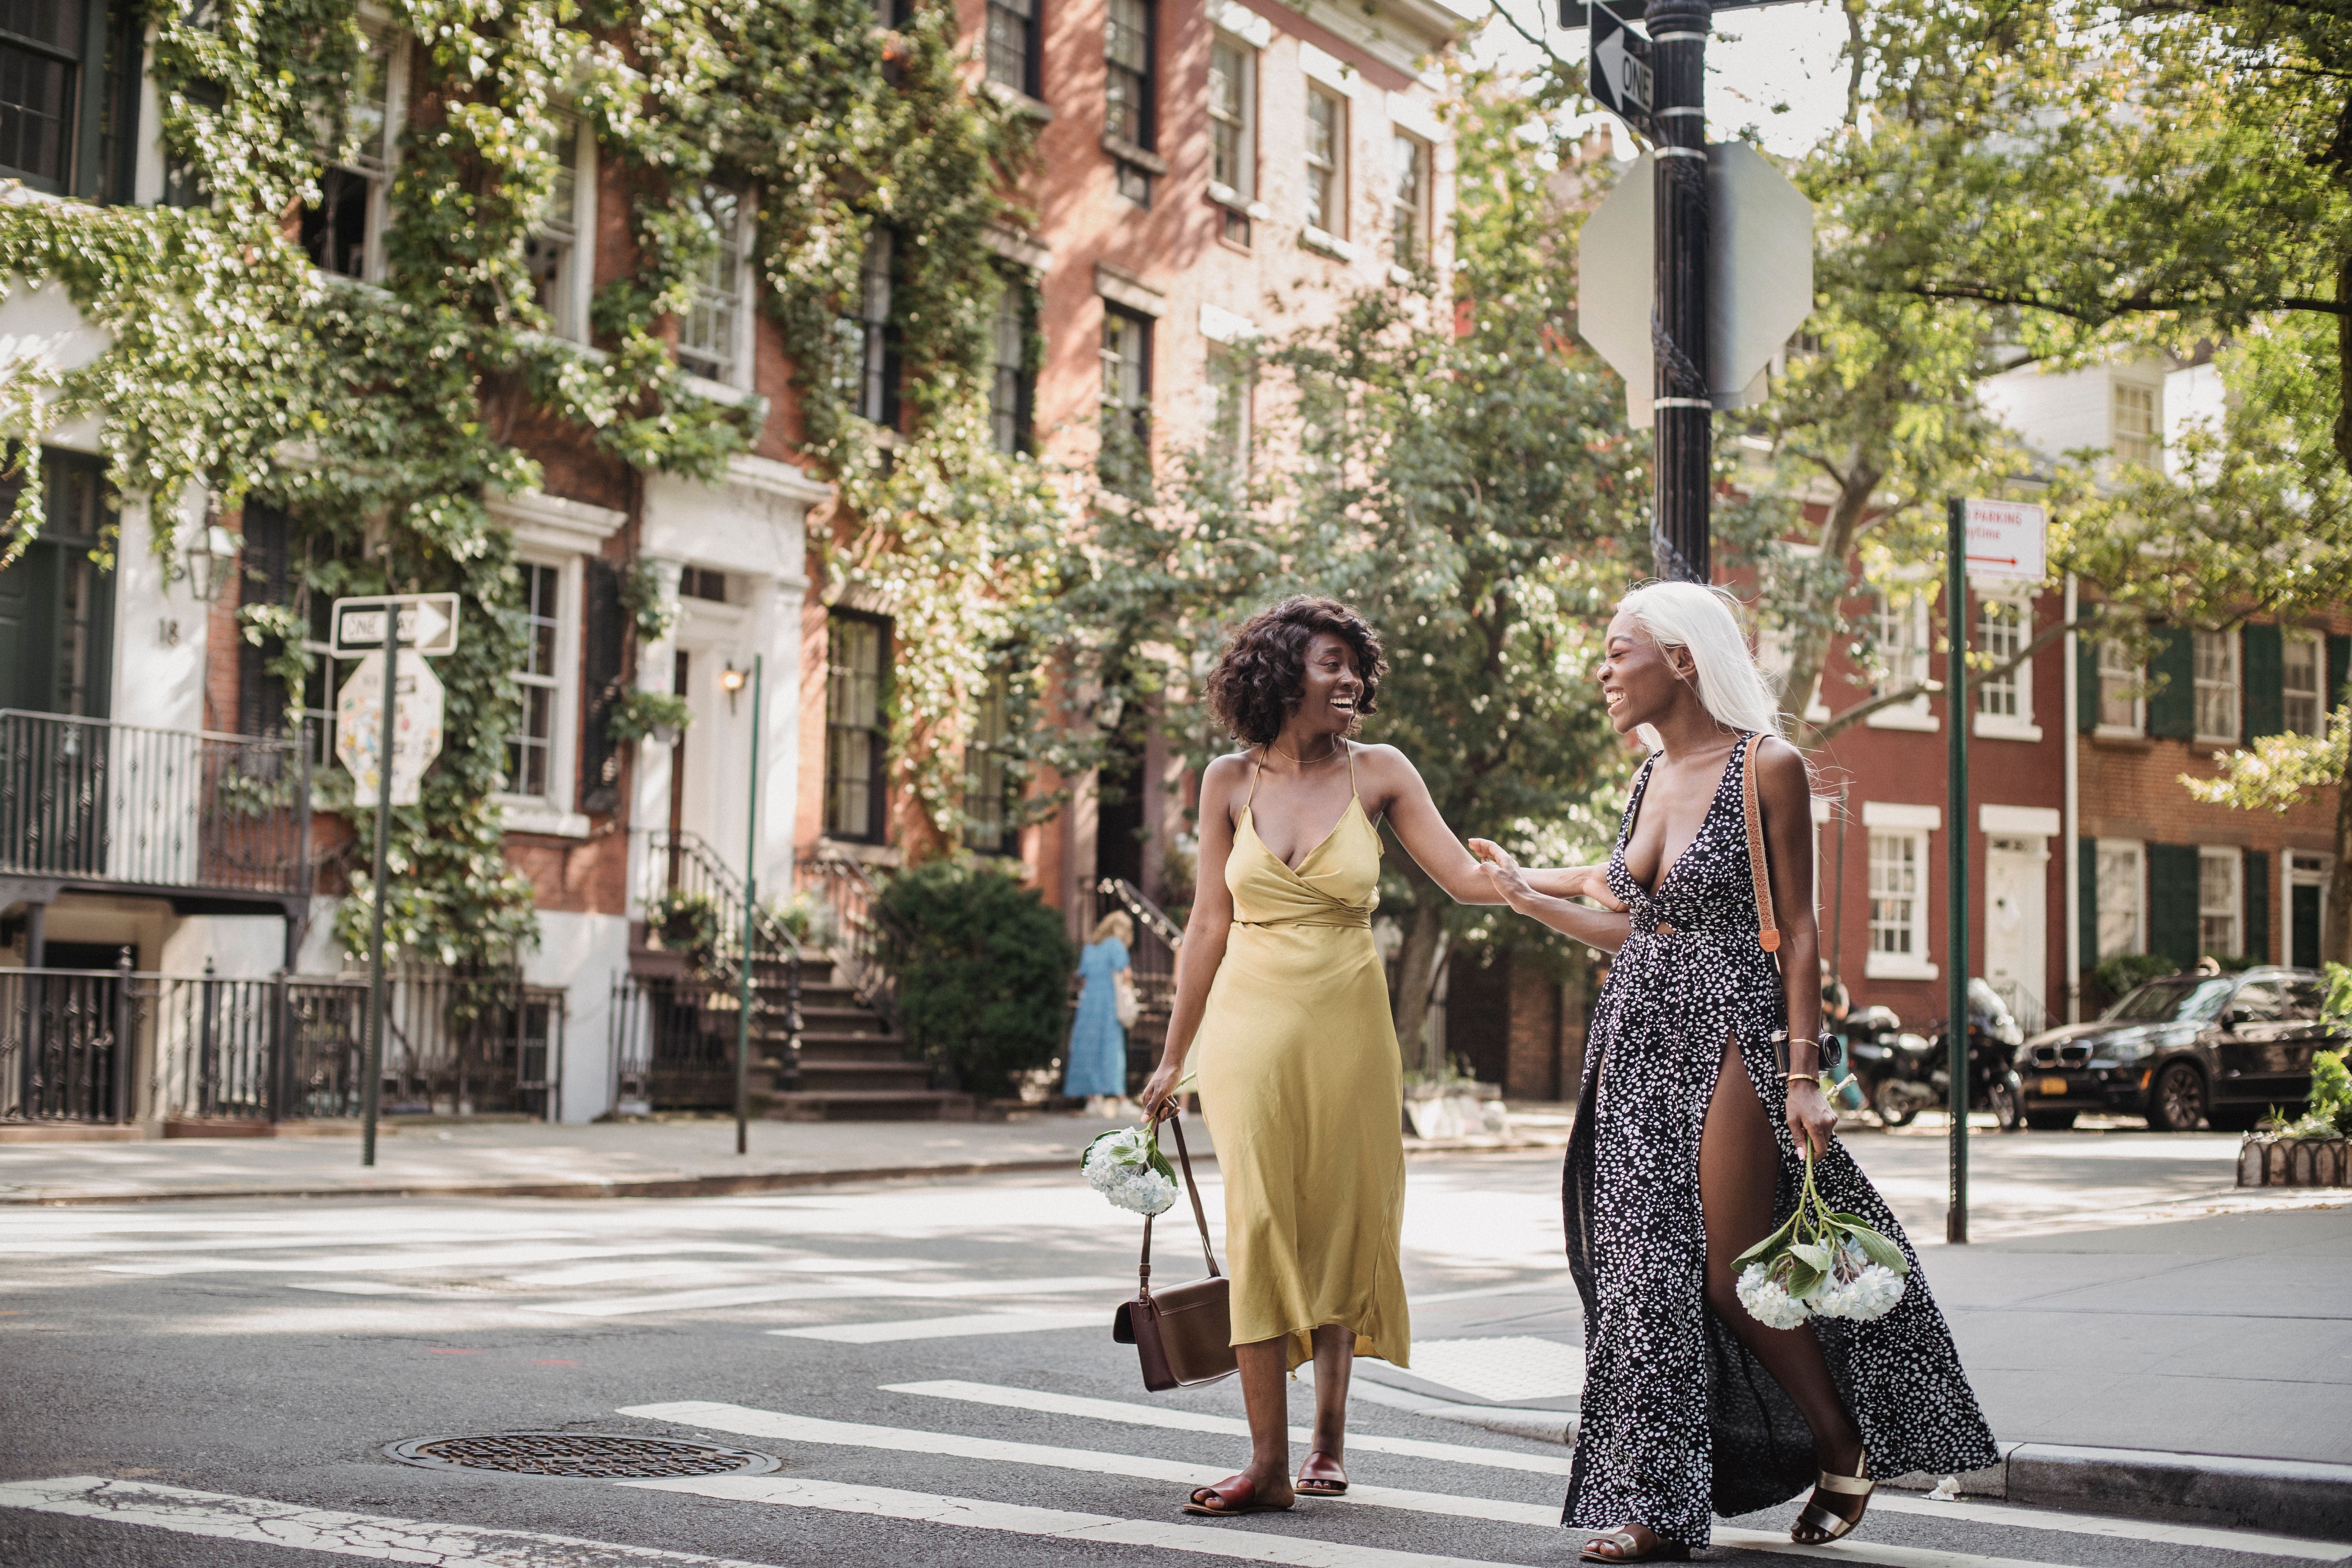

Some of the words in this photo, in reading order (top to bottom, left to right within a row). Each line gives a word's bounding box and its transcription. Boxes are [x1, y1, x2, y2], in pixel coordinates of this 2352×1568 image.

[1623, 55, 1650, 107] ONE
[1973, 509, 2022, 526] PARKING
[1965, 526, 2000, 540] nytime
